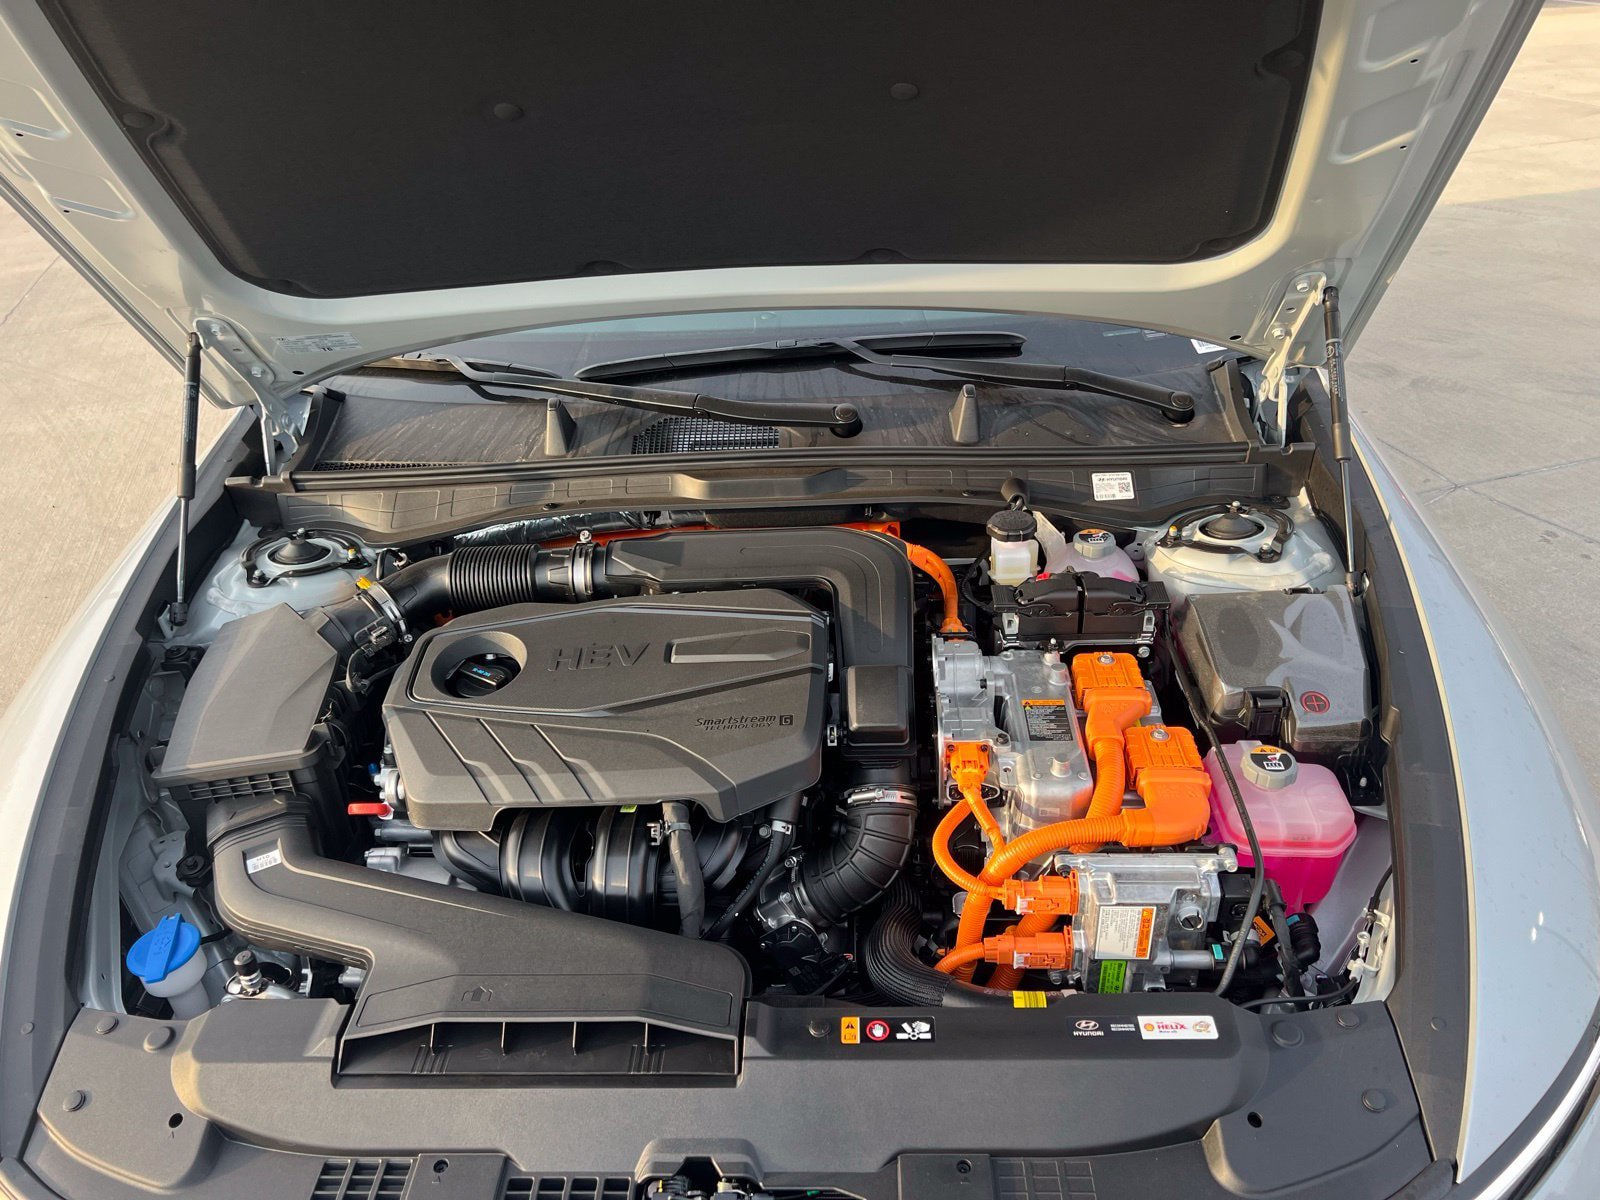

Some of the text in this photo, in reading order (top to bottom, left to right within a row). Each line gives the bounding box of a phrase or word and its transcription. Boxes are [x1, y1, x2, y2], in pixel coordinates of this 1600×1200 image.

[547, 641, 651, 672] HEV
[695, 714, 794, 727] Smartstream G
[704, 721, 774, 731] TECHNOLOGY
